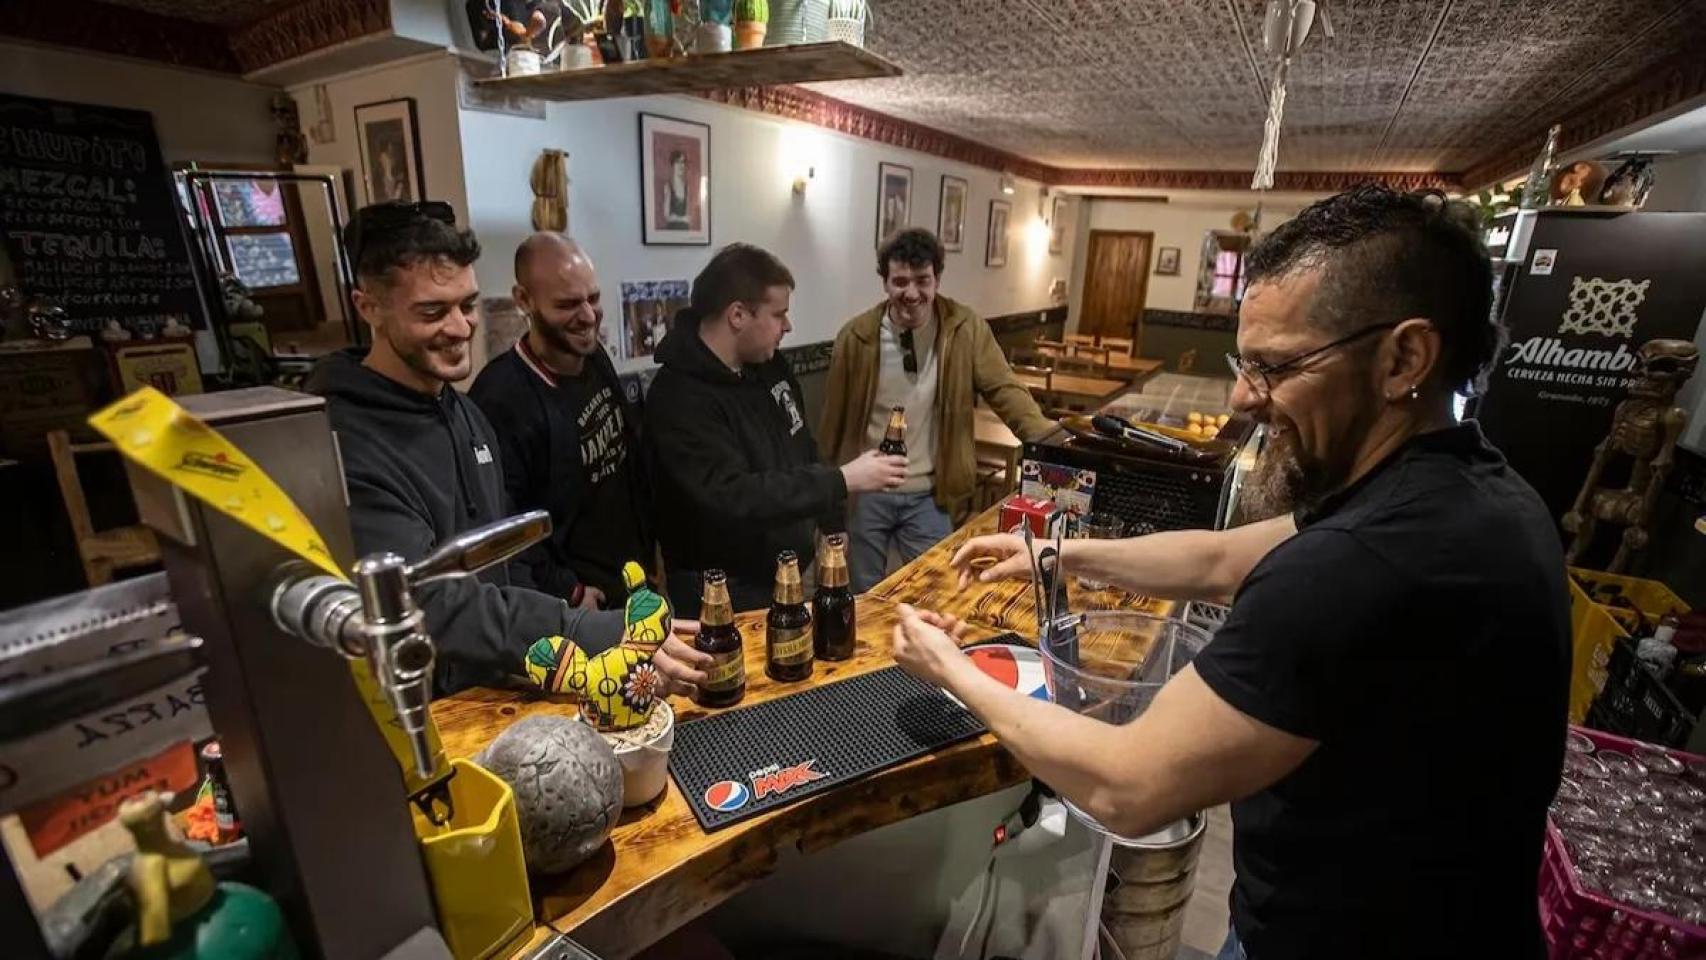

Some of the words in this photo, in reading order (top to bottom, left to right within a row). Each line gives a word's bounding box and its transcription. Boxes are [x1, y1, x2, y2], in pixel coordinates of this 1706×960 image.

[1507, 367, 1554, 382] CERVEZA
[1557, 371, 1593, 385] HECHA
[1597, 375, 1617, 388] SIN
